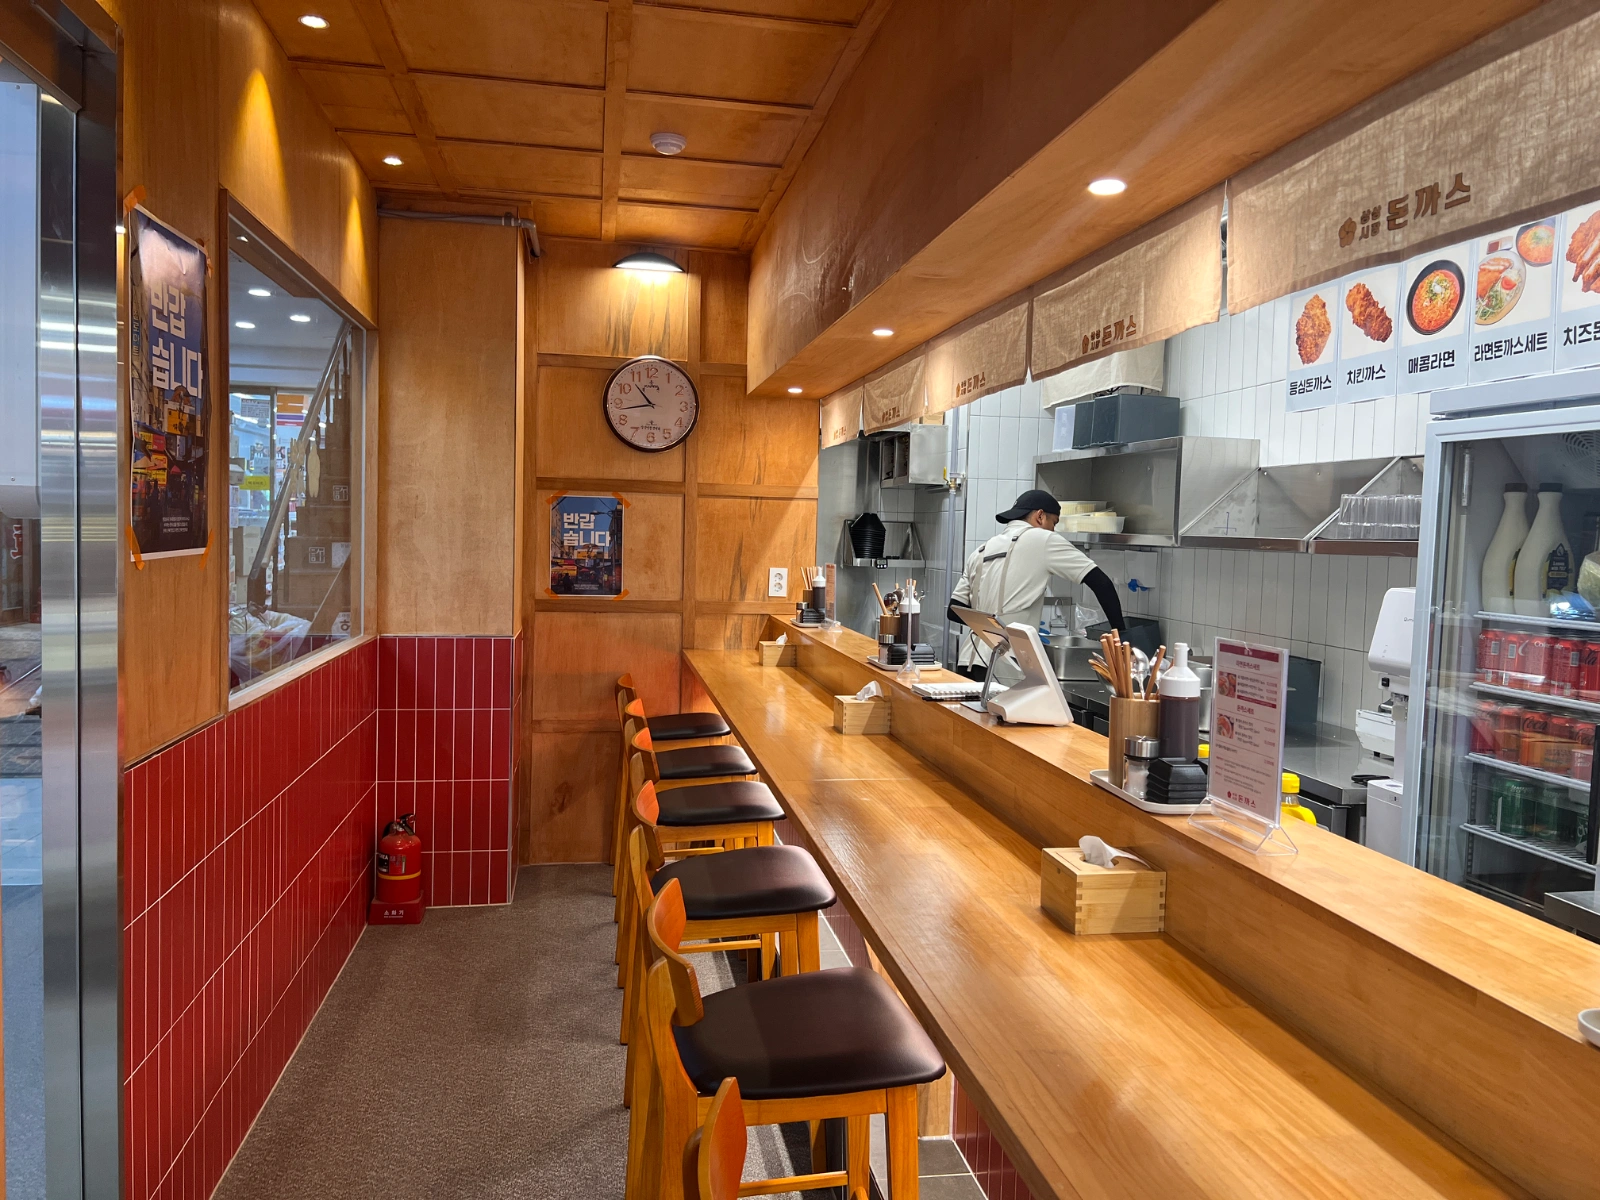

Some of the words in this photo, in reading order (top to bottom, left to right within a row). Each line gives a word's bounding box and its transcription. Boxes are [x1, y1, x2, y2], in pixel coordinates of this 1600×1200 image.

[1386, 172, 1471, 231] 돈까스
[151, 281, 186, 340] 반갑
[1101, 315, 1137, 348] 돈까스
[1474, 331, 1548, 362] 라면돈까스세트
[152, 337, 204, 399] 습니다
[1407, 349, 1456, 375] 매콤라면
[630, 370, 641, 382] 11
[645, 367, 659, 379] 12
[666, 372, 671, 384] 1
[1346, 364, 1386, 386] 치킨까스
[618, 383, 632, 394] 10
[675, 385, 684, 396] 2
[1289, 374, 1332, 396] 등심돈까스
[613, 397, 623, 410] 9
[679, 401, 688, 413] 3
[619, 414, 628, 426] 8
[674, 417, 683, 428] 4
[630, 426, 640, 440] 7
[646, 432, 655, 444] 6
[663, 428, 672, 440] 5
[563, 512, 596, 529] 반갑
[563, 530, 611, 547] 습니다
